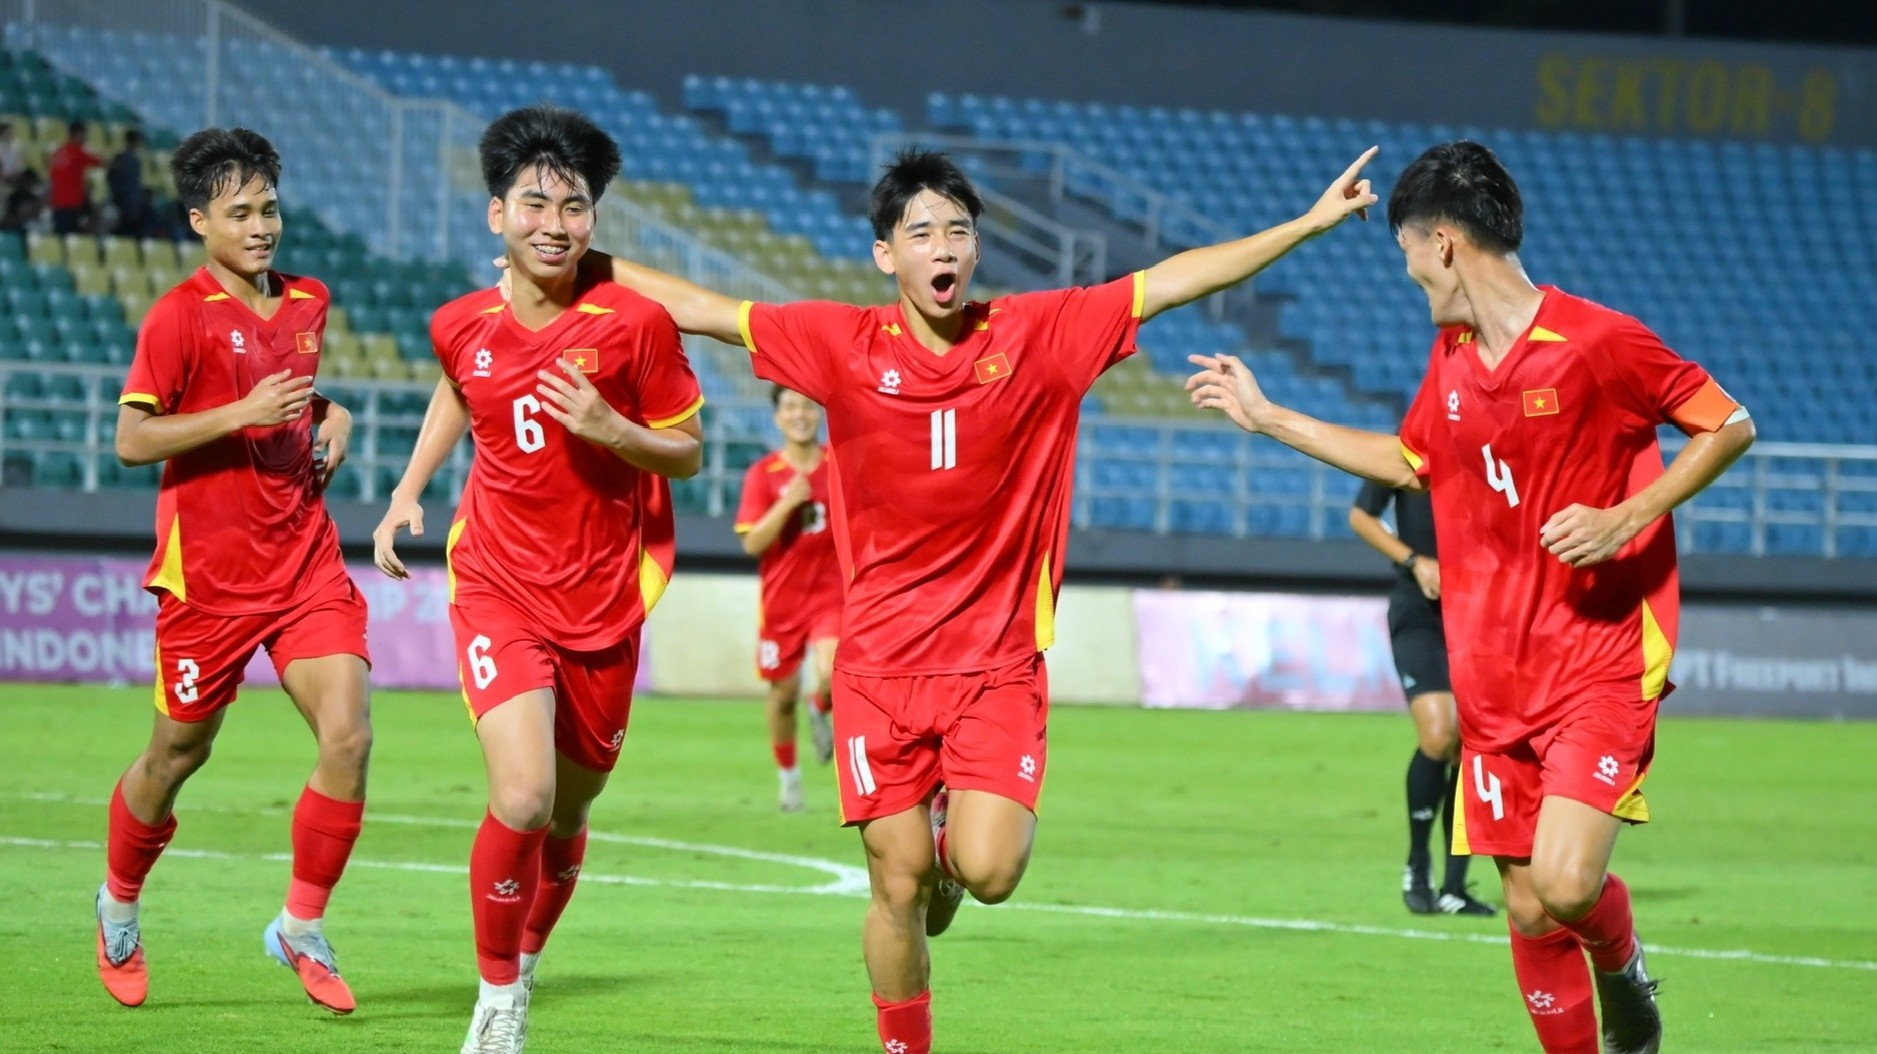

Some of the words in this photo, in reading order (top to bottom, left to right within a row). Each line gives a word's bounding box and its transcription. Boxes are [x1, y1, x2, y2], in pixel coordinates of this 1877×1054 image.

[1537, 54, 1836, 141] SEKTOR-8
[512, 394, 546, 454] 6
[930, 407, 957, 471] 11
[1481, 443, 1520, 508] 4
[175, 659, 199, 704] 3
[467, 634, 498, 690] 6
[848, 735, 876, 796] 11
[1473, 754, 1504, 821] 4
